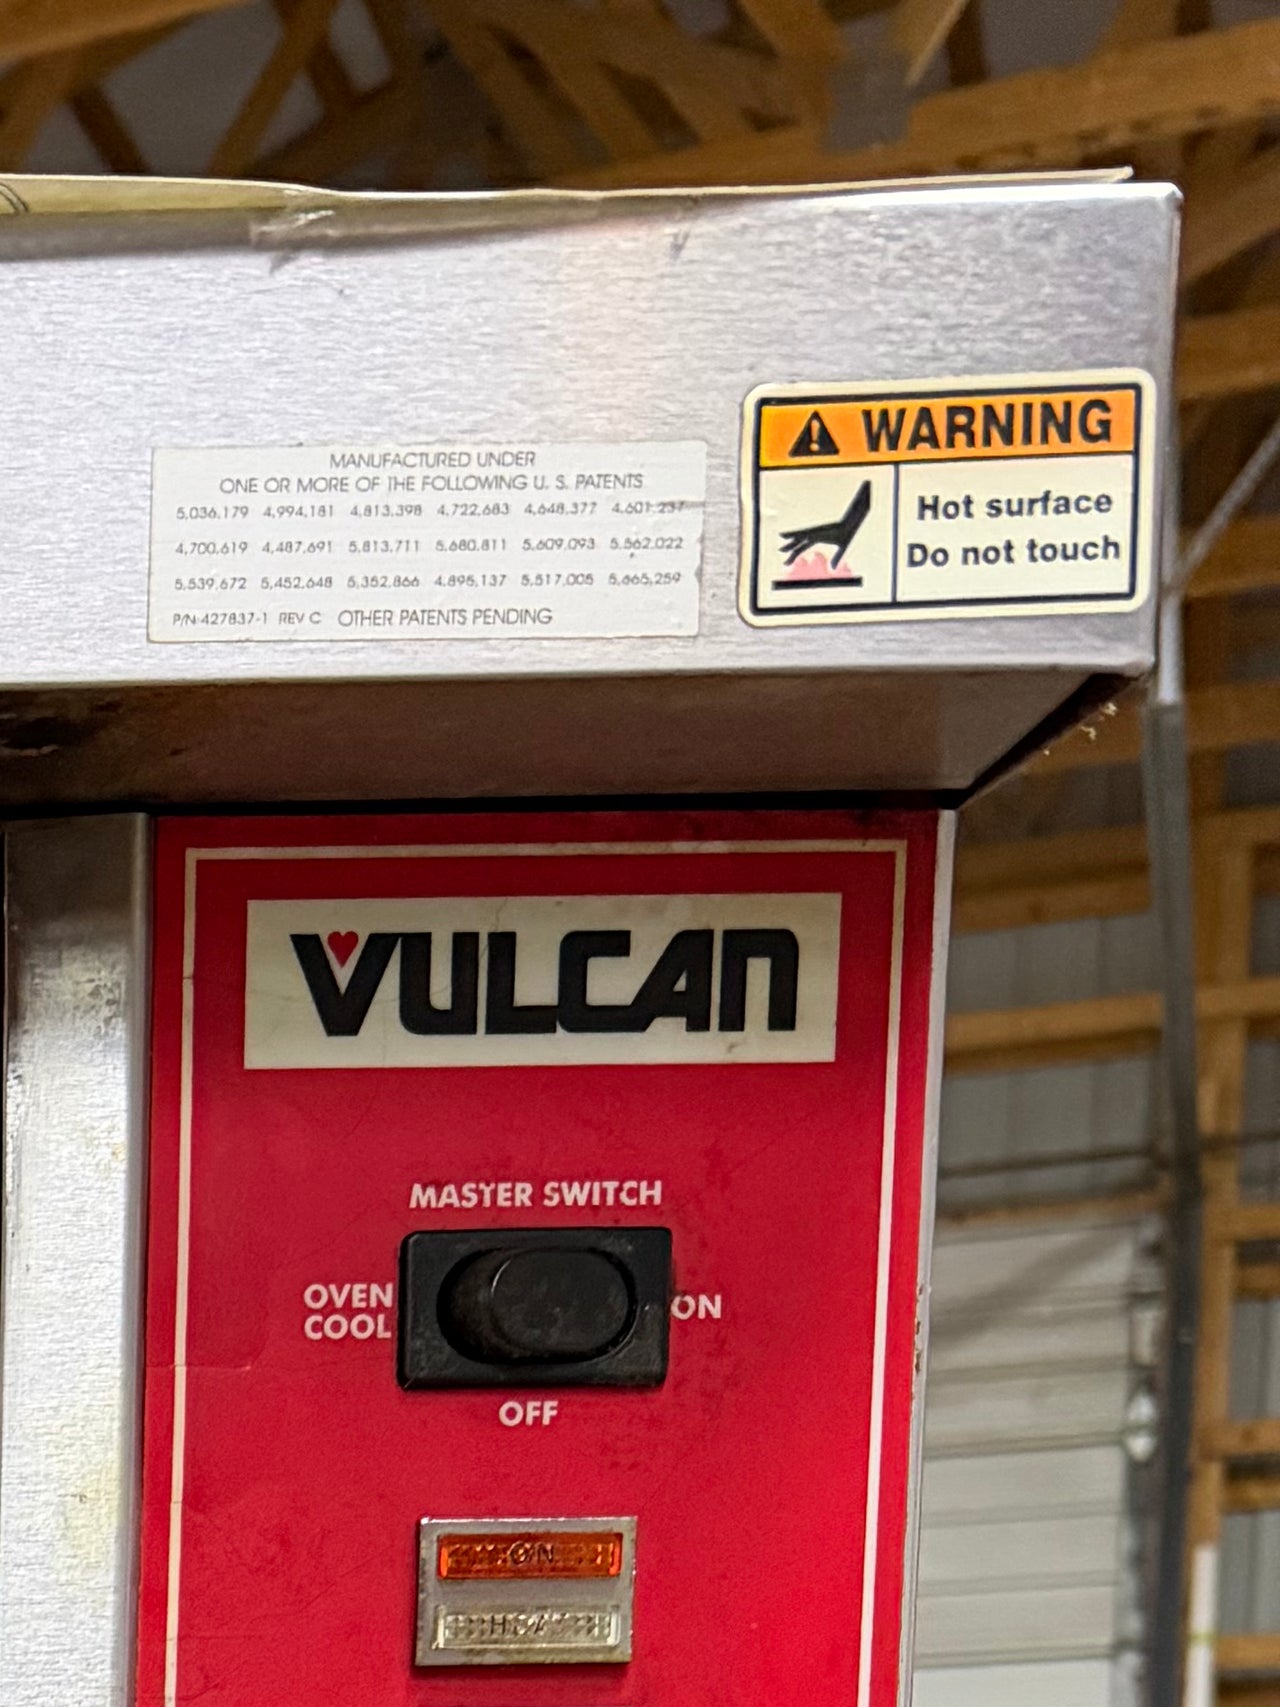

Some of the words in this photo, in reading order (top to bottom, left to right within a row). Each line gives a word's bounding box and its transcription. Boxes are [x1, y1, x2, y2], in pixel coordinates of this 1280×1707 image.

[862, 399, 1112, 452] WARNING
[330, 453, 471, 469] MANUFACTURED
[478, 451, 536, 467] UNDER
[220, 478, 258, 494] ONE
[264, 477, 291, 493] OR
[297, 477, 349, 493] MORE
[355, 476, 380, 493] OF
[387, 475, 415, 492] THE
[421, 475, 528, 491] FOLLOWING
[575, 473, 643, 489] PATENTS
[917, 495, 974, 521] Hot
[986, 490, 1112, 518] surface
[907, 542, 949, 569] Do
[961, 540, 1014, 565] not
[1026, 535, 1120, 562] touch
[278, 613, 304, 625] REV
[309, 612, 322, 624] C
[338, 609, 393, 627] OTHER
[399, 609, 467, 626] PATENTS
[472, 608, 553, 625] PENDING
[289, 928, 799, 1037] VULCAN
[409, 1182, 533, 1208] MASTER
[543, 1180, 663, 1207] SWITCH
[303, 1284, 393, 1309] OVEN
[671, 1294, 722, 1320] ON
[303, 1315, 391, 1341] COOL
[498, 1401, 558, 1427] OFF
